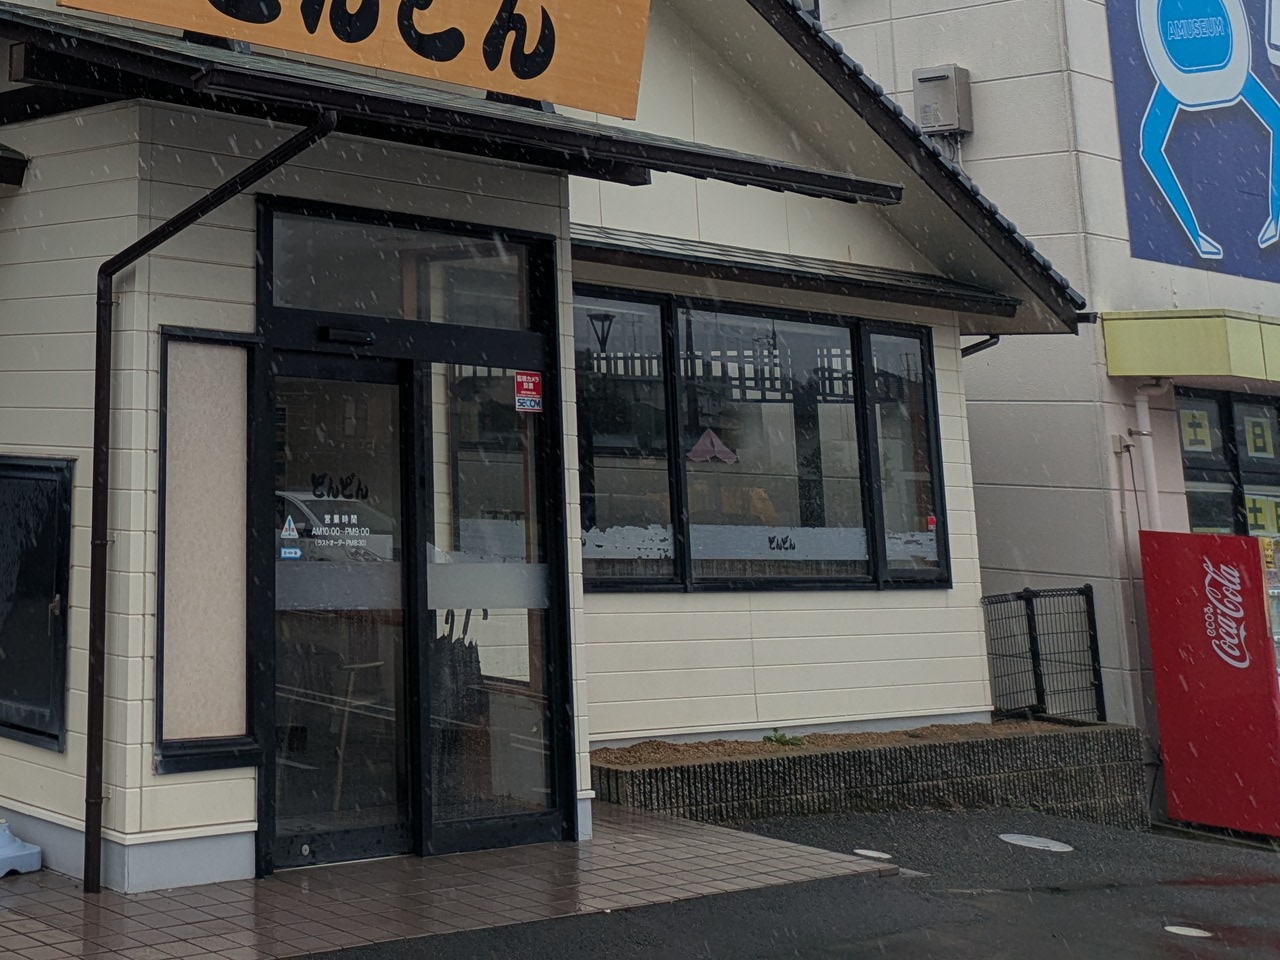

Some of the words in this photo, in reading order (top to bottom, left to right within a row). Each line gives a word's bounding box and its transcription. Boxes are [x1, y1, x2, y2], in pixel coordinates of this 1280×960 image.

[1167, 16, 1225, 41] AMUSEUM
[517, 398, 541, 408] SECOM
[1188, 414, 1206, 447] 土
[311, 472, 369, 500] どんどん
[324, 514, 358, 525] 営業時間
[1249, 498, 1266, 531] 土
[768, 535, 796, 551] どんどん
[1203, 555, 1251, 669] Coca-Cola
